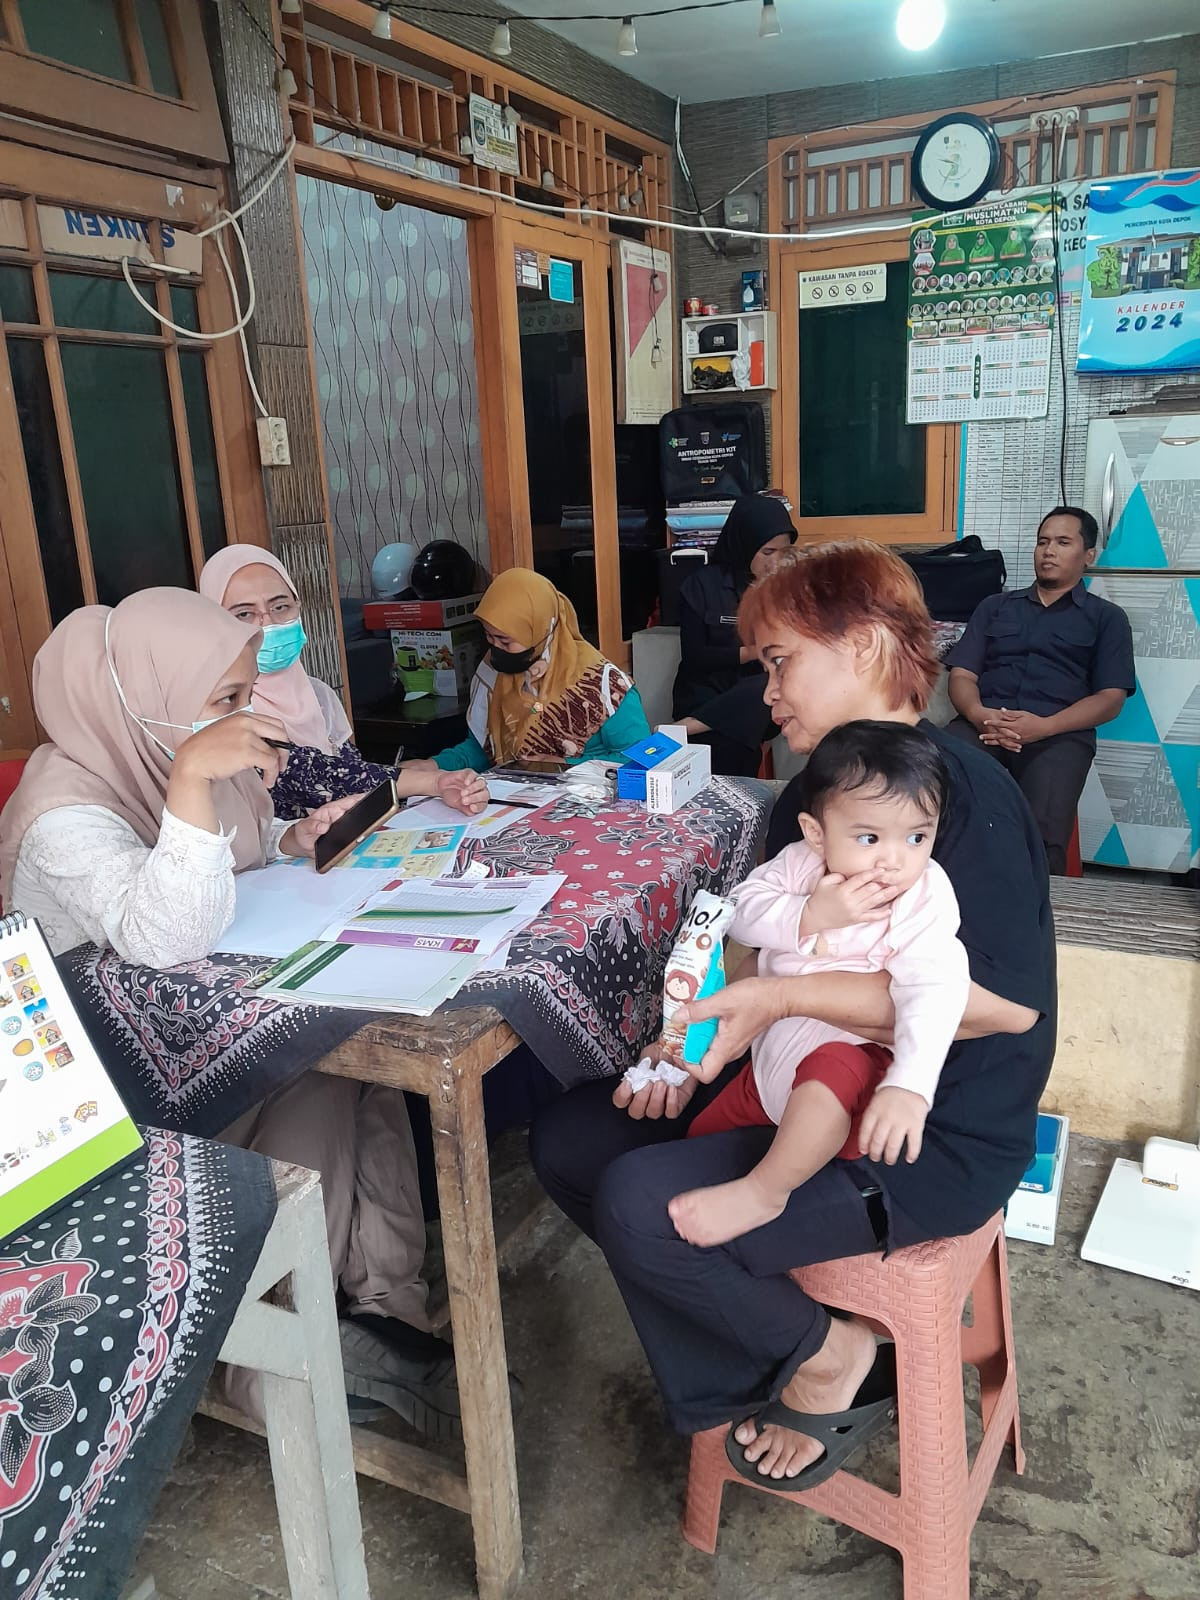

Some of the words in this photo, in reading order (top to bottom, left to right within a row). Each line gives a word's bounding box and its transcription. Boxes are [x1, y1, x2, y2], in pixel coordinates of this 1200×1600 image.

[1060, 215, 1087, 232] OSY
[808, 273, 837, 283] KAWASAN
[838, 271, 857, 280] TANPA
[858, 269, 878, 277] ROKOK
[1116, 300, 1186, 315] KALENDER
[1115, 312, 1184, 333] 2024
[415, 938, 440, 947] KMS
